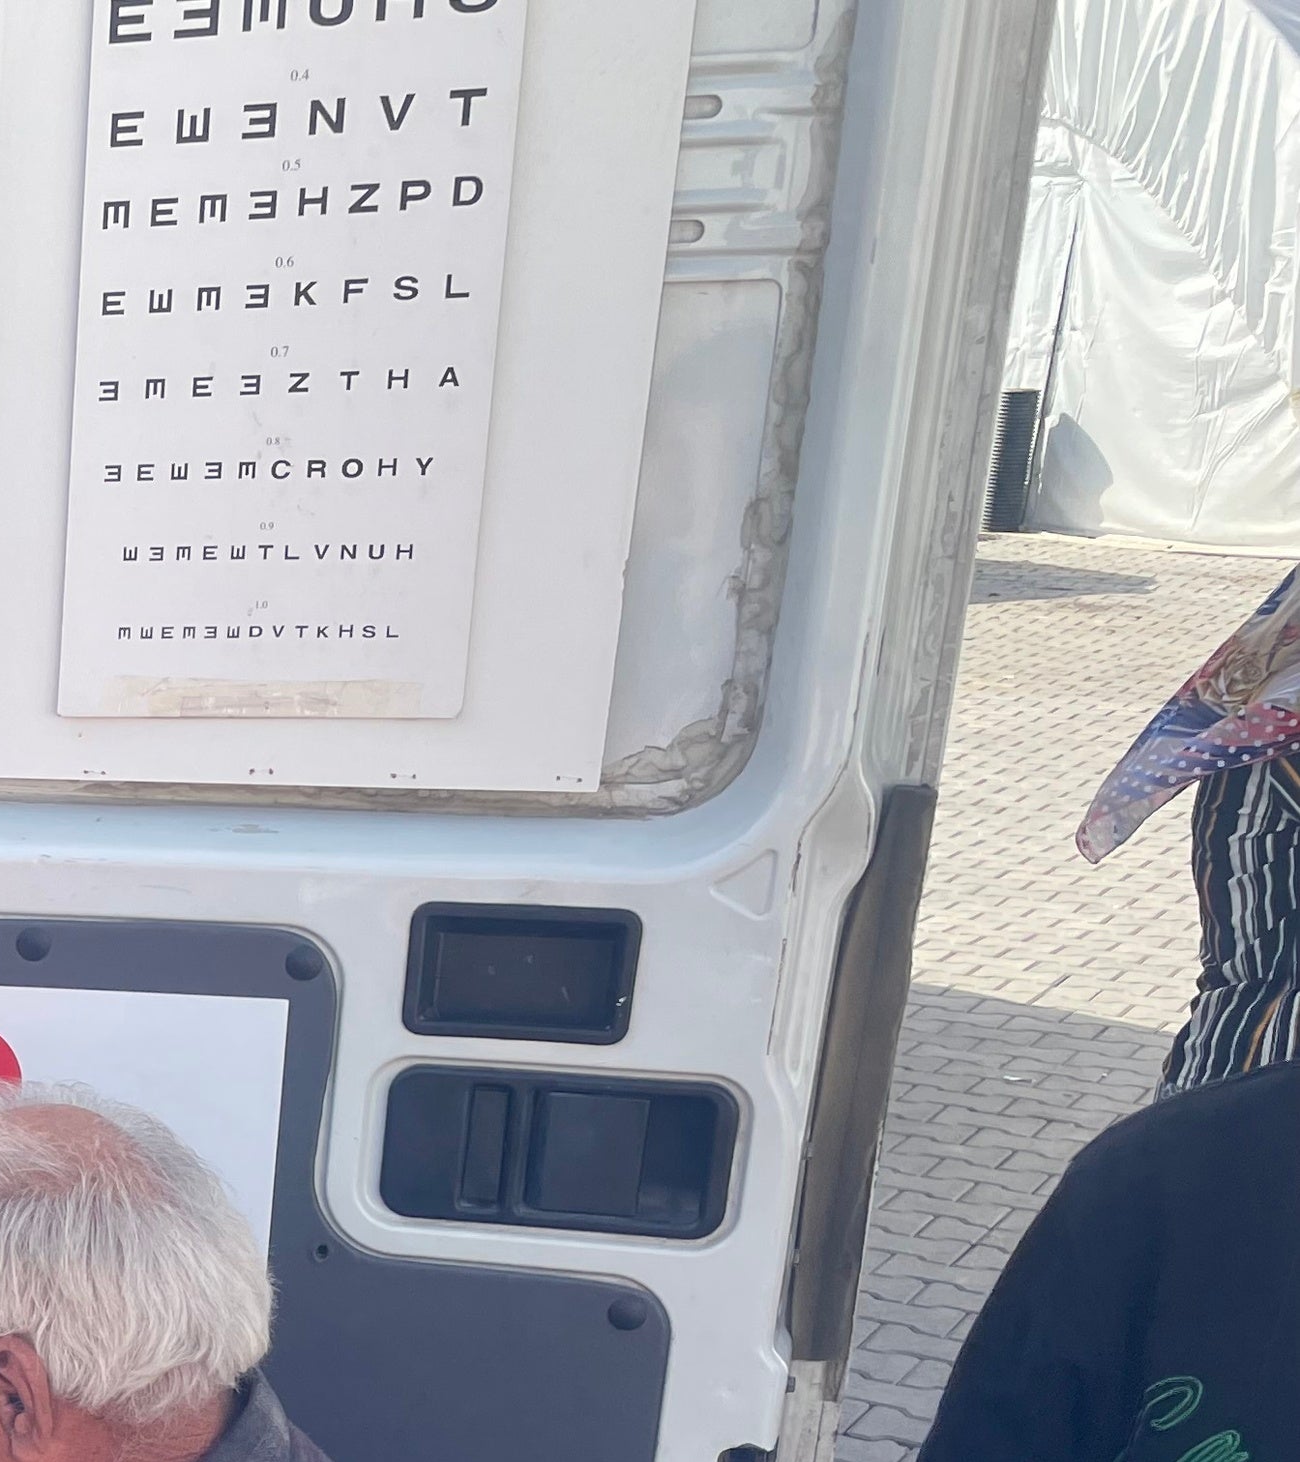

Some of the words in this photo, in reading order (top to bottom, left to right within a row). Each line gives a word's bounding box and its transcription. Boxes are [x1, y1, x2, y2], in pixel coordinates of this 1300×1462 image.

[289, 69, 310, 82] 0.4
[281, 159, 301, 172] 0.5
[274, 256, 295, 269] 0.6
[270, 345, 290, 358] 0.7
[265, 436, 281, 446] 0.8
